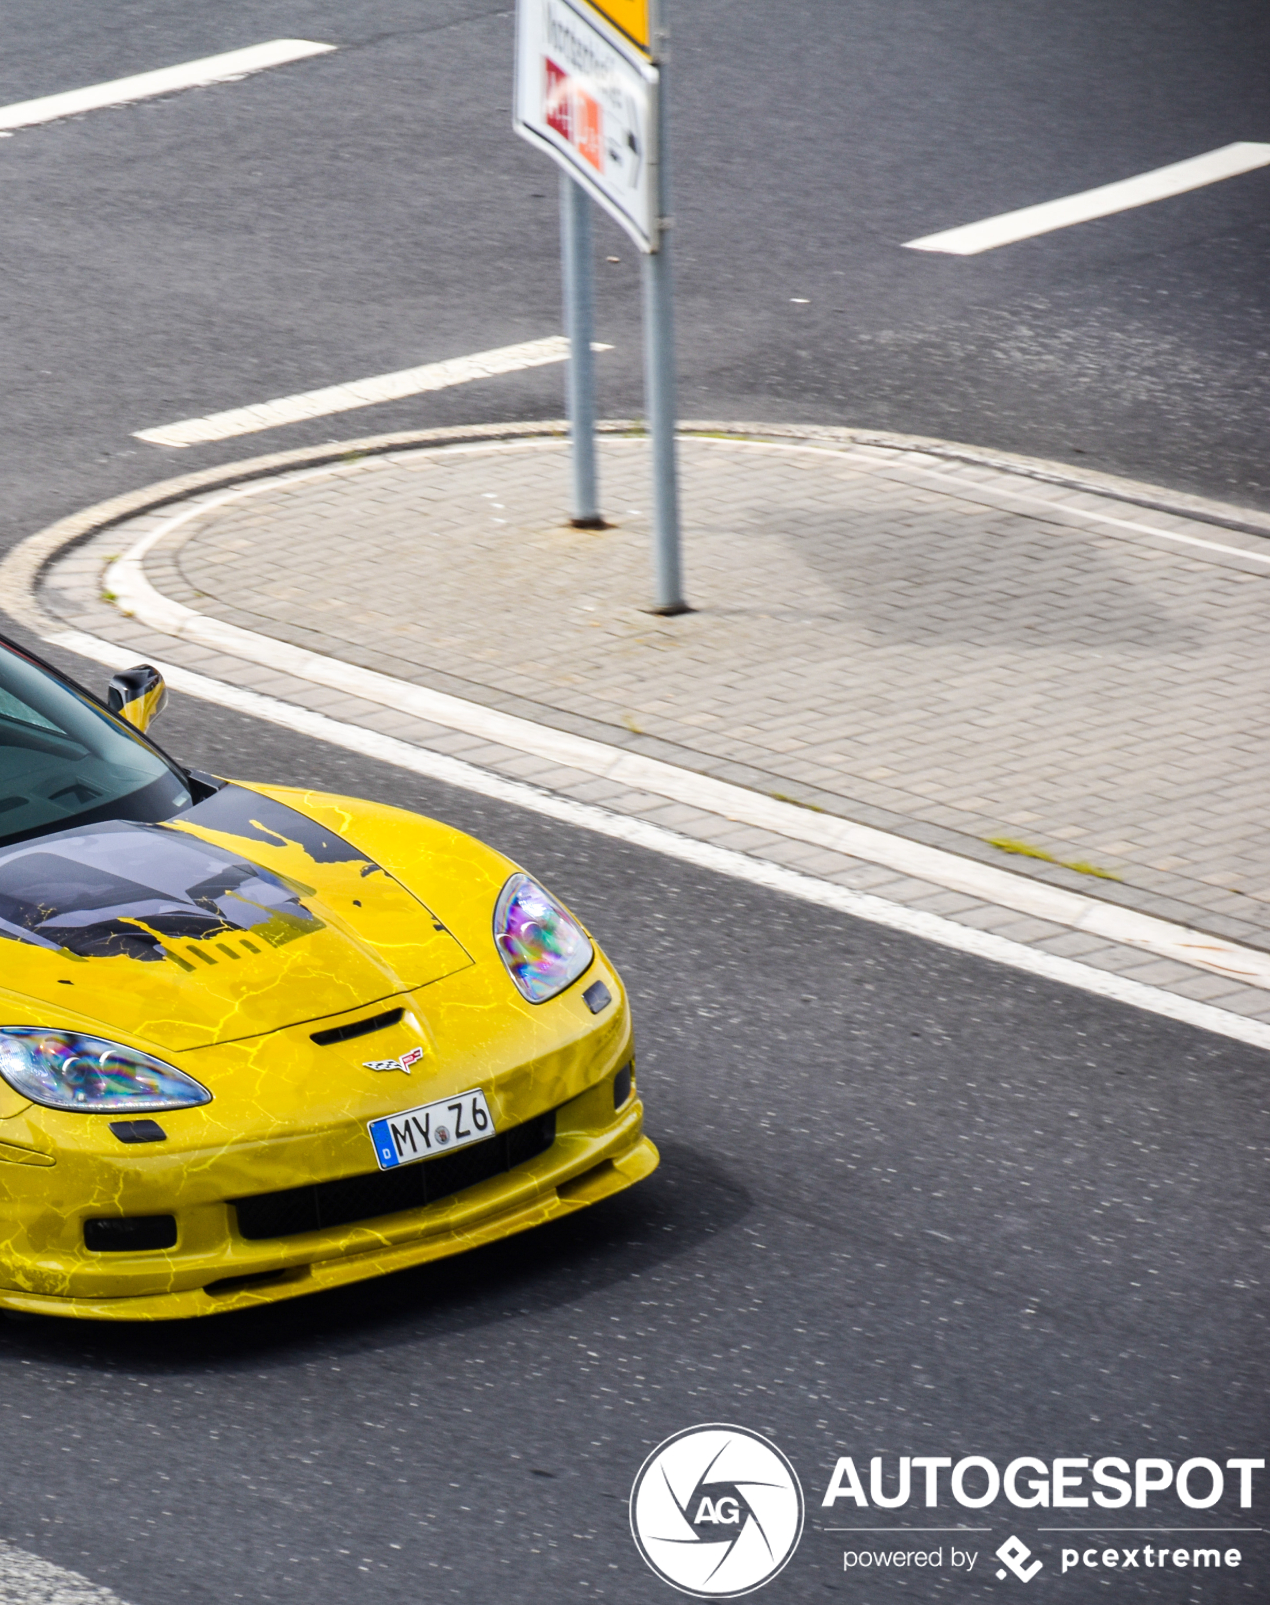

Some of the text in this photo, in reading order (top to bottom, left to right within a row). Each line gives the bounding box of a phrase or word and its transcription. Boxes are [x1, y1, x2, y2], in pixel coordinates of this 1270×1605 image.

[390, 1097, 488, 1157] MY Z6
[382, 1148, 392, 1160] D
